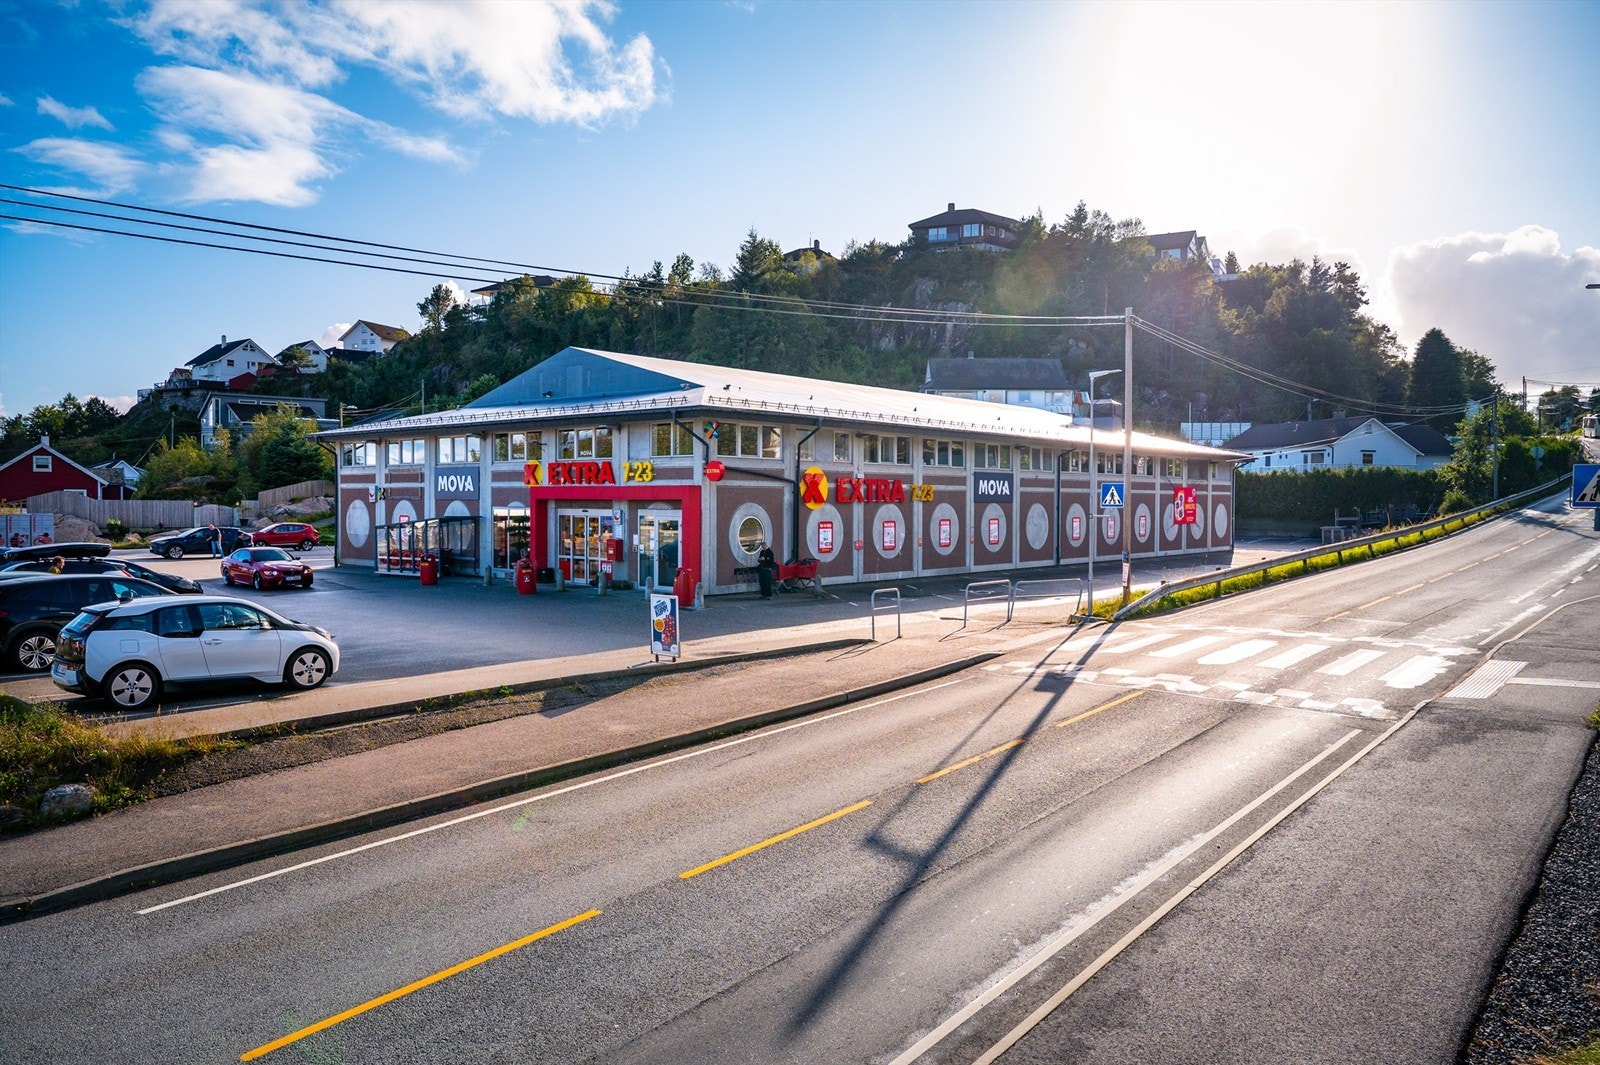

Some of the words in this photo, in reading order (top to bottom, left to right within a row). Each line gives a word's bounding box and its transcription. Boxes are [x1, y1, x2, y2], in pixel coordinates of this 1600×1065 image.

[547, 461, 615, 485] EXTRA
[622, 462, 653, 483] 7-23
[438, 475, 474, 492] MOVA
[836, 477, 906, 503] EXTRA
[911, 484, 935, 502] 7-23
[978, 479, 1010, 495] MOVA
